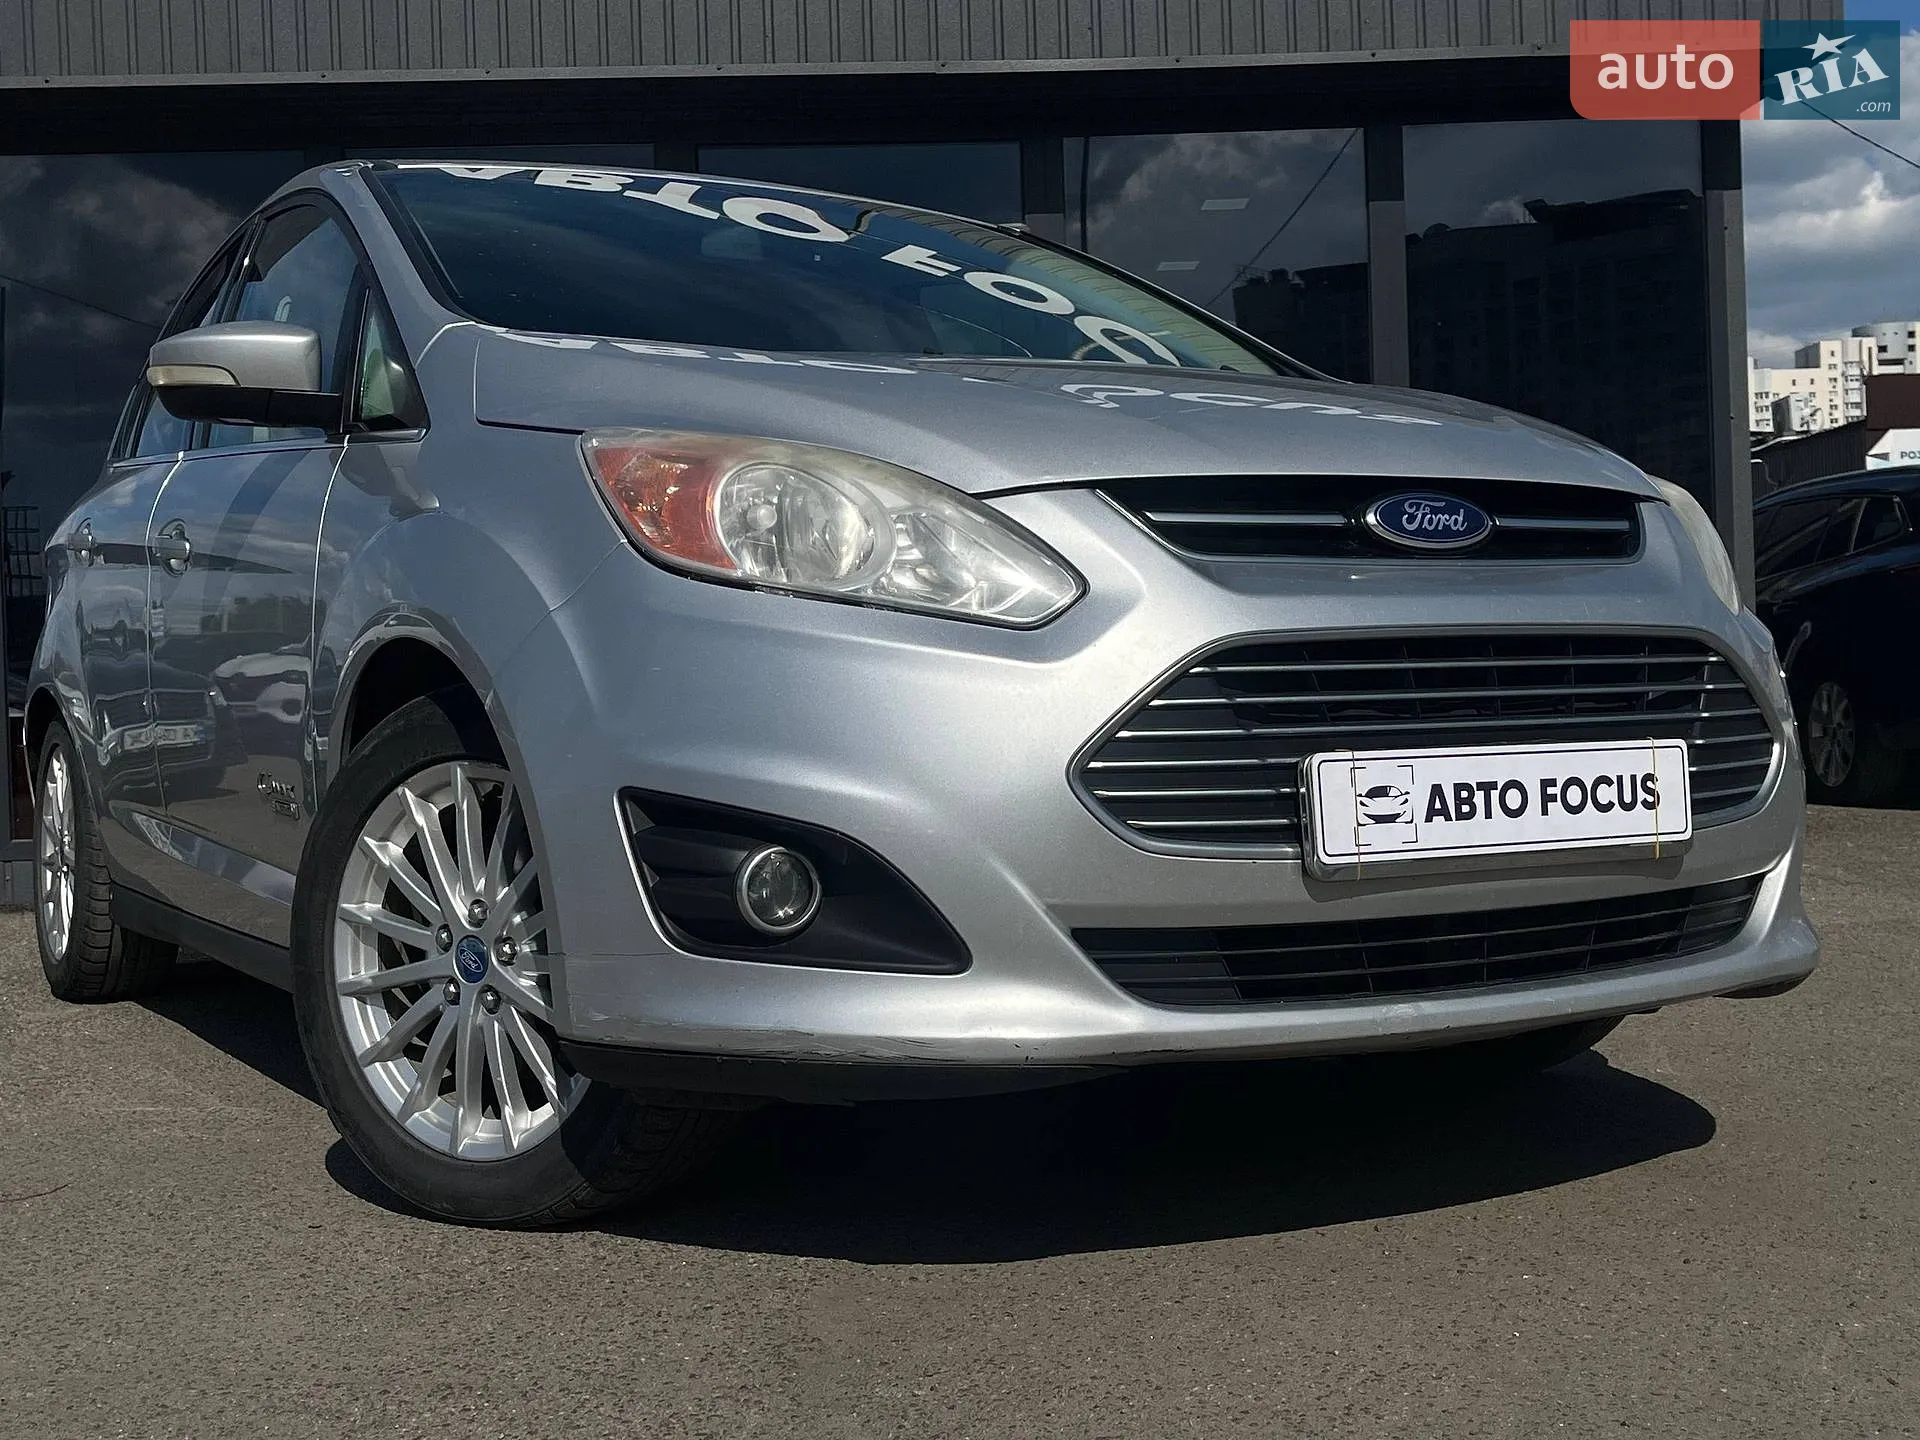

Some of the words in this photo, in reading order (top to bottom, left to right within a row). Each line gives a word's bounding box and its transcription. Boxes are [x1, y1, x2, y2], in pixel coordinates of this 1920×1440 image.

[1401, 499, 1468, 531] Ford
[1424, 779, 1529, 824] АВТО
[1540, 772, 1661, 817] FOCUS
[461, 951, 479, 969] Ford
